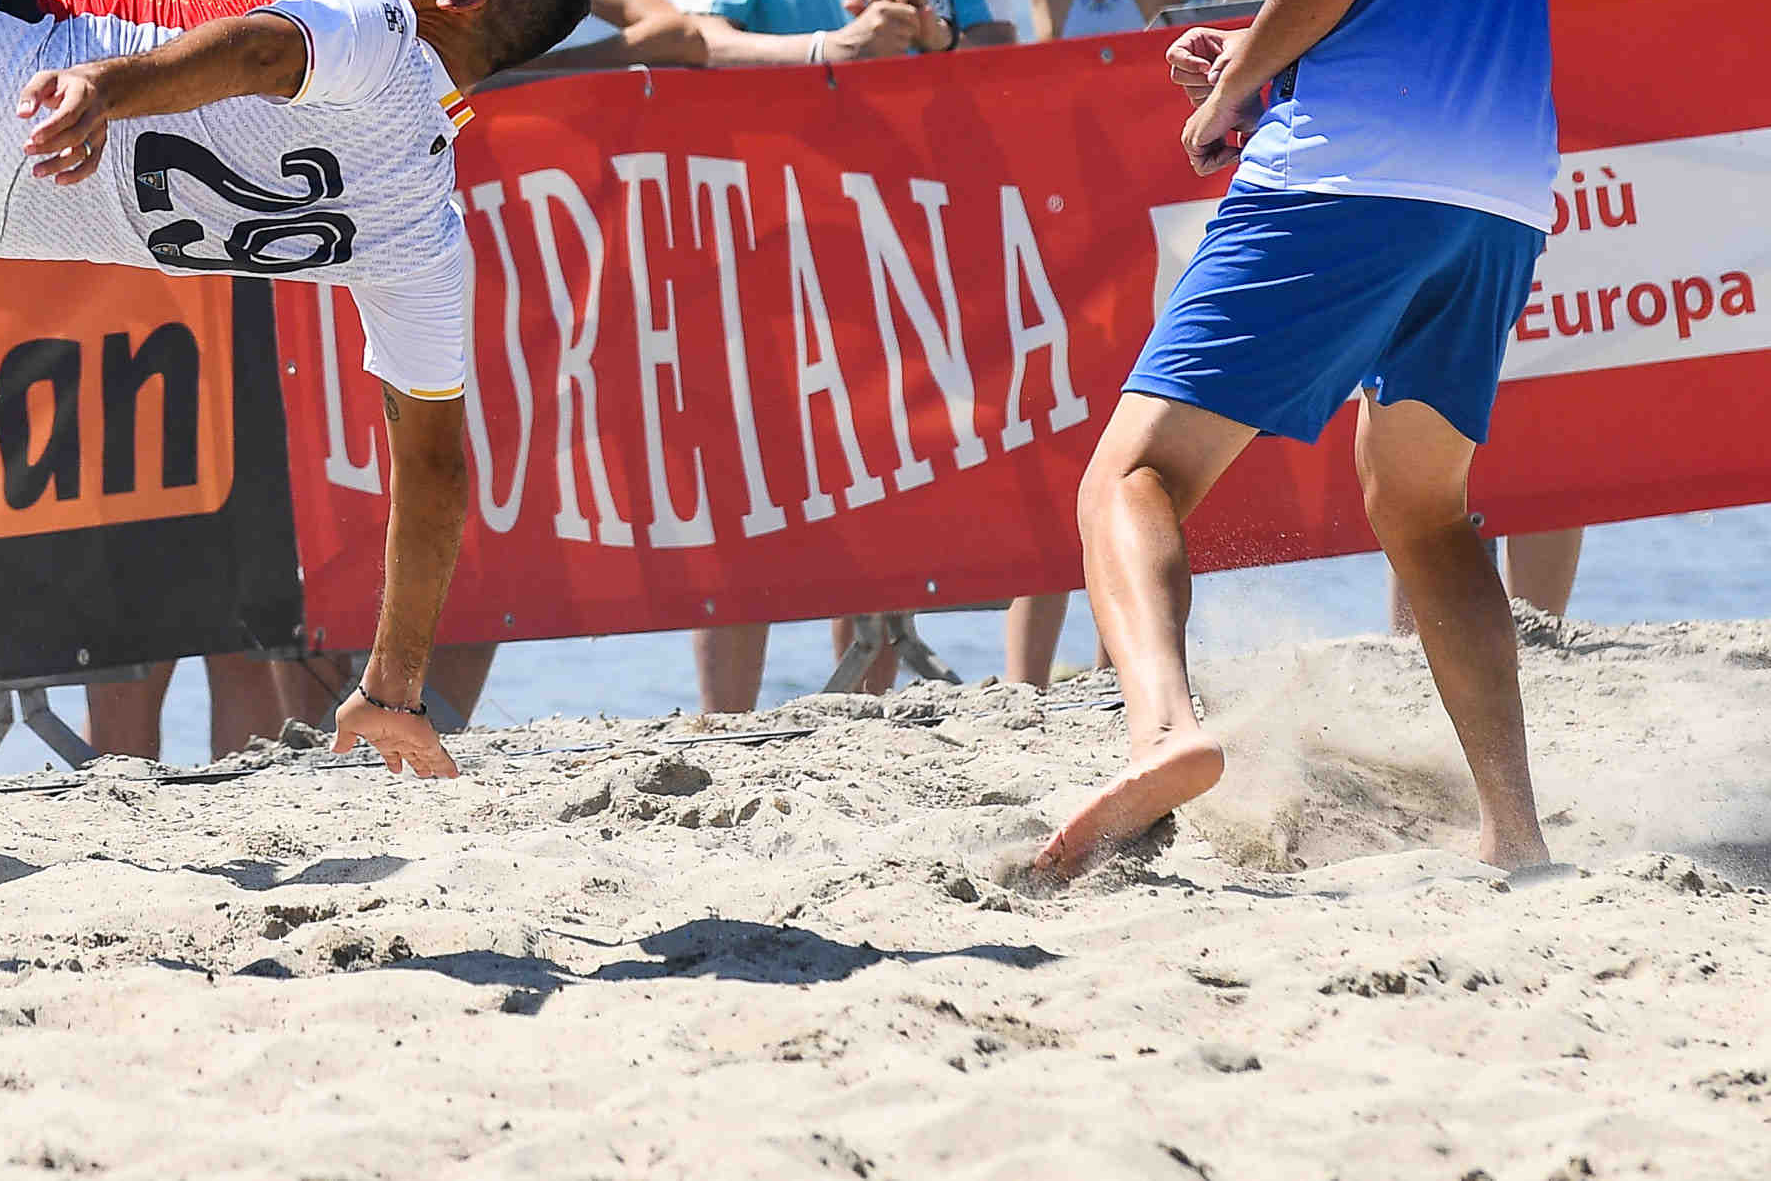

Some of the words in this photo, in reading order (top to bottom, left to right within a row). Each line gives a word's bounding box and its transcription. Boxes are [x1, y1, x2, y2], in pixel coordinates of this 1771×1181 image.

[134, 131, 356, 273] 29
[317, 153, 1090, 550] LURETANA
[1516, 270, 1756, 340] Europa
